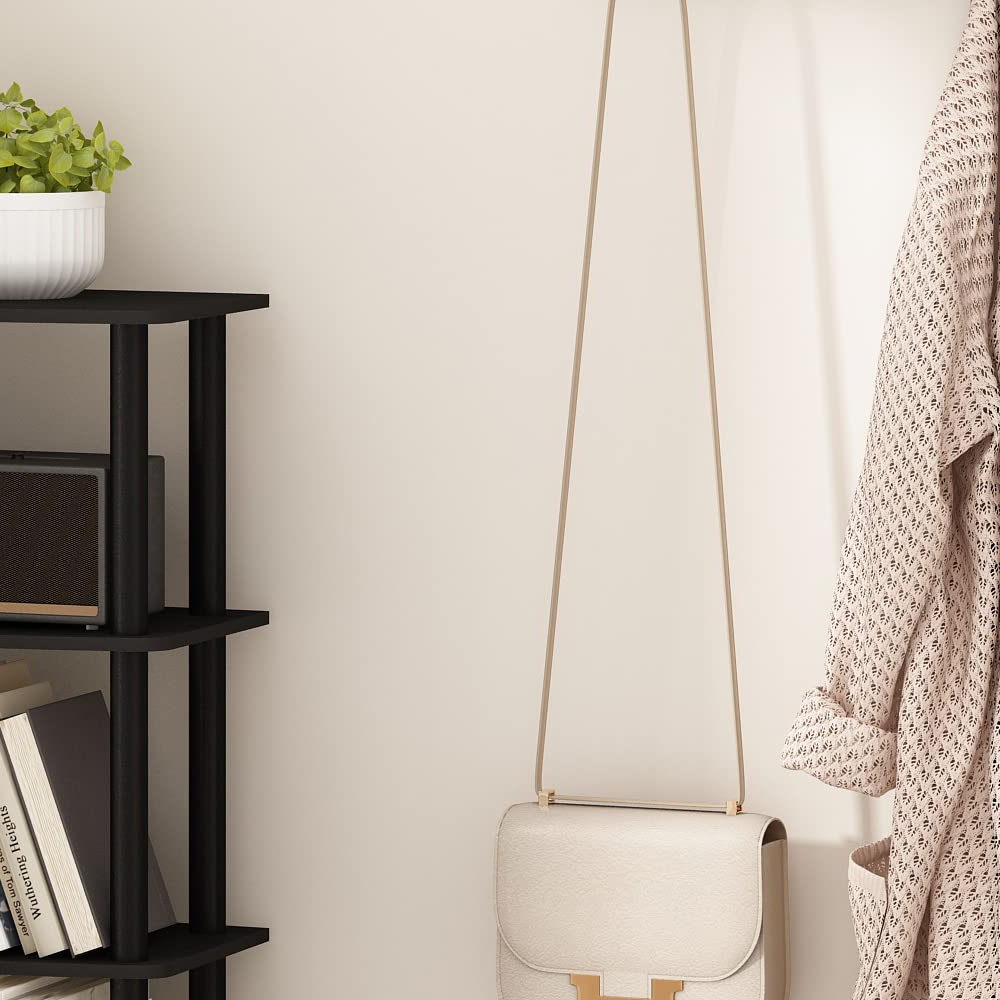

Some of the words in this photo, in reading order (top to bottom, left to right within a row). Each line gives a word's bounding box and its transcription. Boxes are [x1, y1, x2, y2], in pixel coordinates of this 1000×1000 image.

[0, 805, 20, 853] Heights
[2, 865, 11, 876] of
[6, 876, 16, 898] Tom
[17, 855, 42, 920] Wuthering
[13, 900, 30, 937] Sawyer
